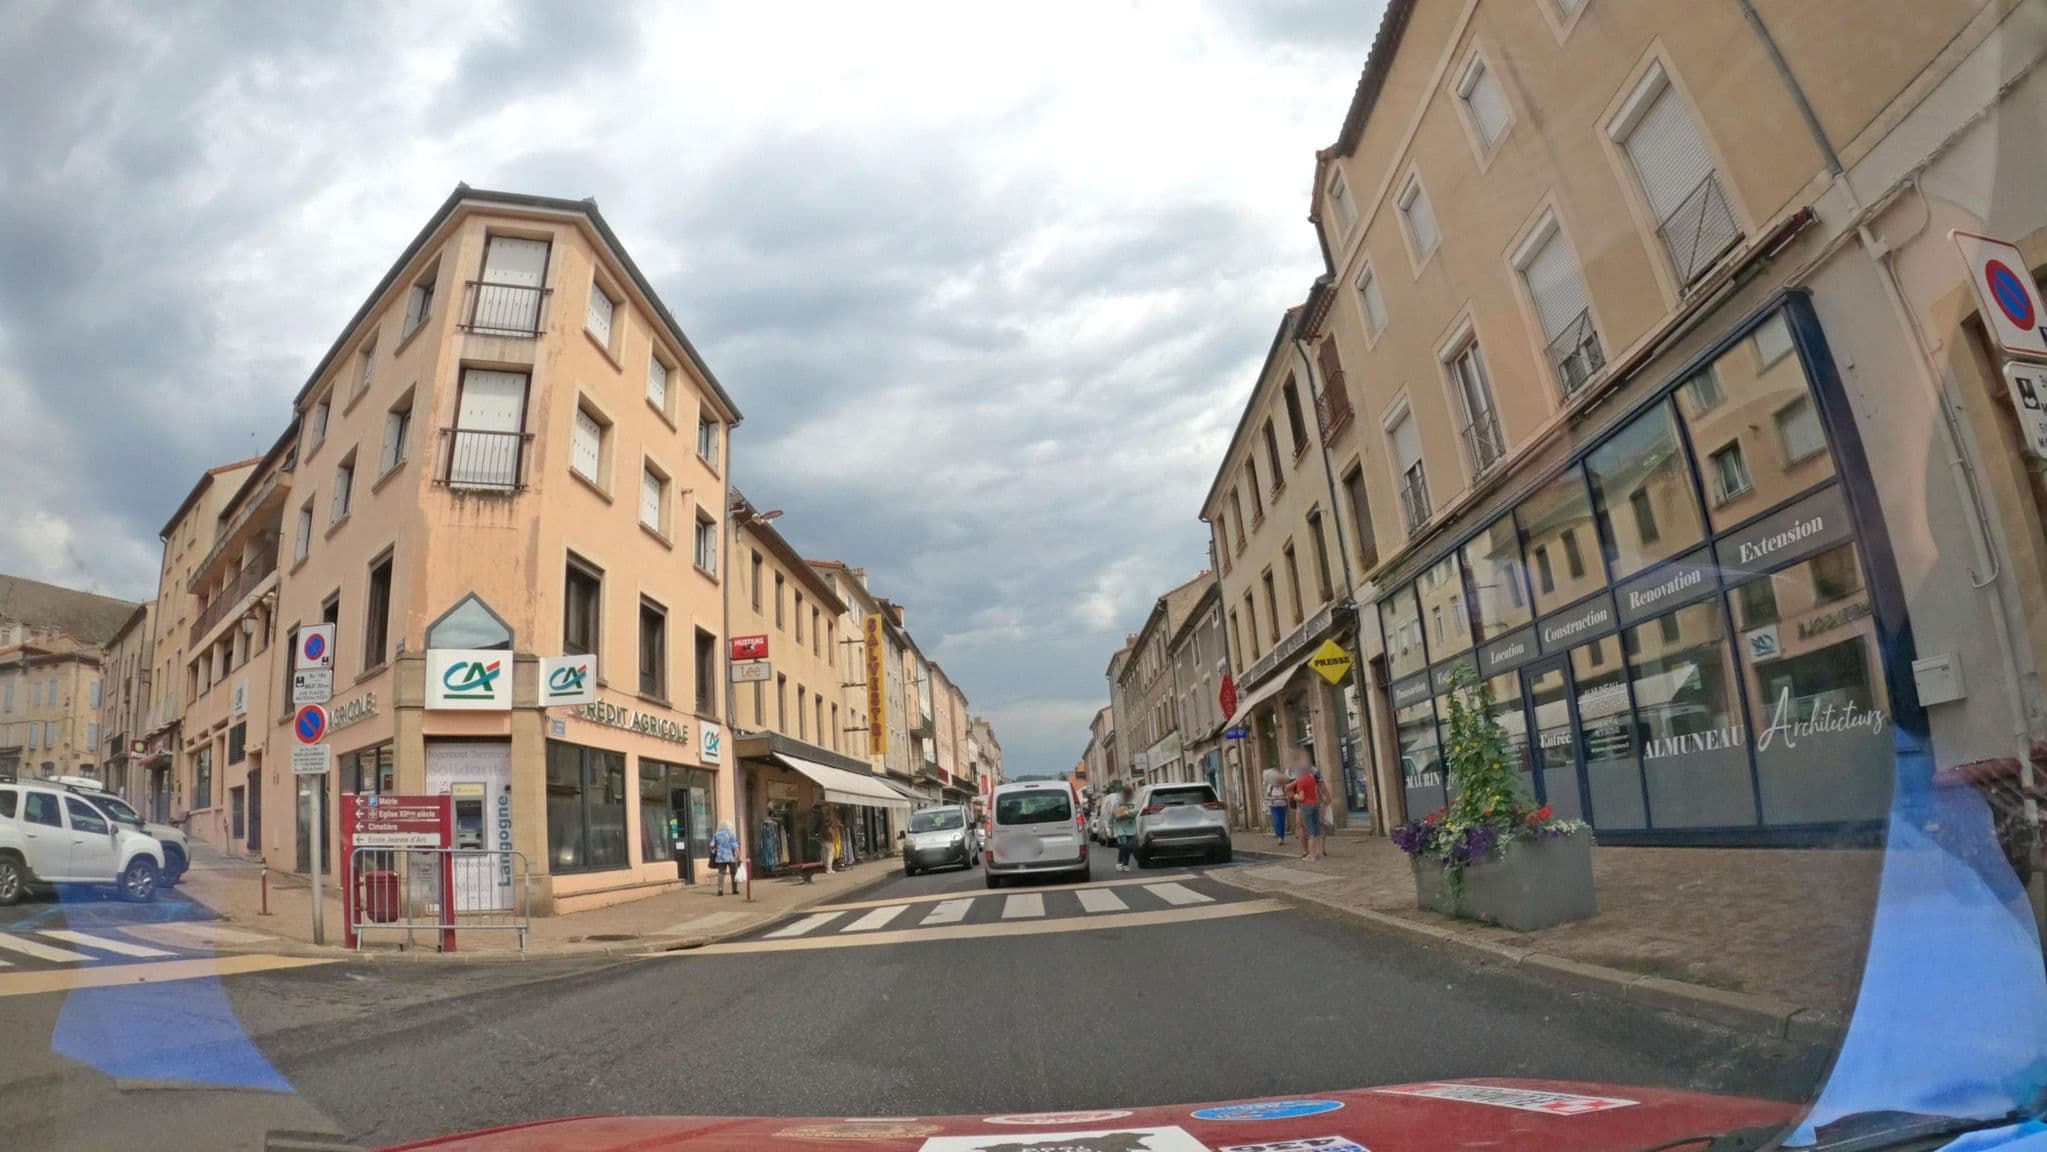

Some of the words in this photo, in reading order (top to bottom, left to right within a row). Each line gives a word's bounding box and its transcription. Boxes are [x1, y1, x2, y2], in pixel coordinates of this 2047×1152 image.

[1739, 516, 1823, 564] Extension
[1629, 567, 1701, 609] Renovation
[1545, 609, 1608, 643] Construction
[1314, 656, 1350, 667] PRESSE
[1490, 643, 1525, 664] Location
[741, 667, 760, 678] Lee
[327, 691, 376, 730] AGRICOLE
[572, 697, 628, 726] CRÉDIT
[631, 711, 689, 742] AGRICOLE
[1644, 724, 1745, 760] ALMUNEAU
[1406, 771, 1441, 789] MAURIN
[379, 797, 398, 805] Mairie
[368, 822, 398, 830] Cimetière
[497, 795, 513, 887] Langogne
